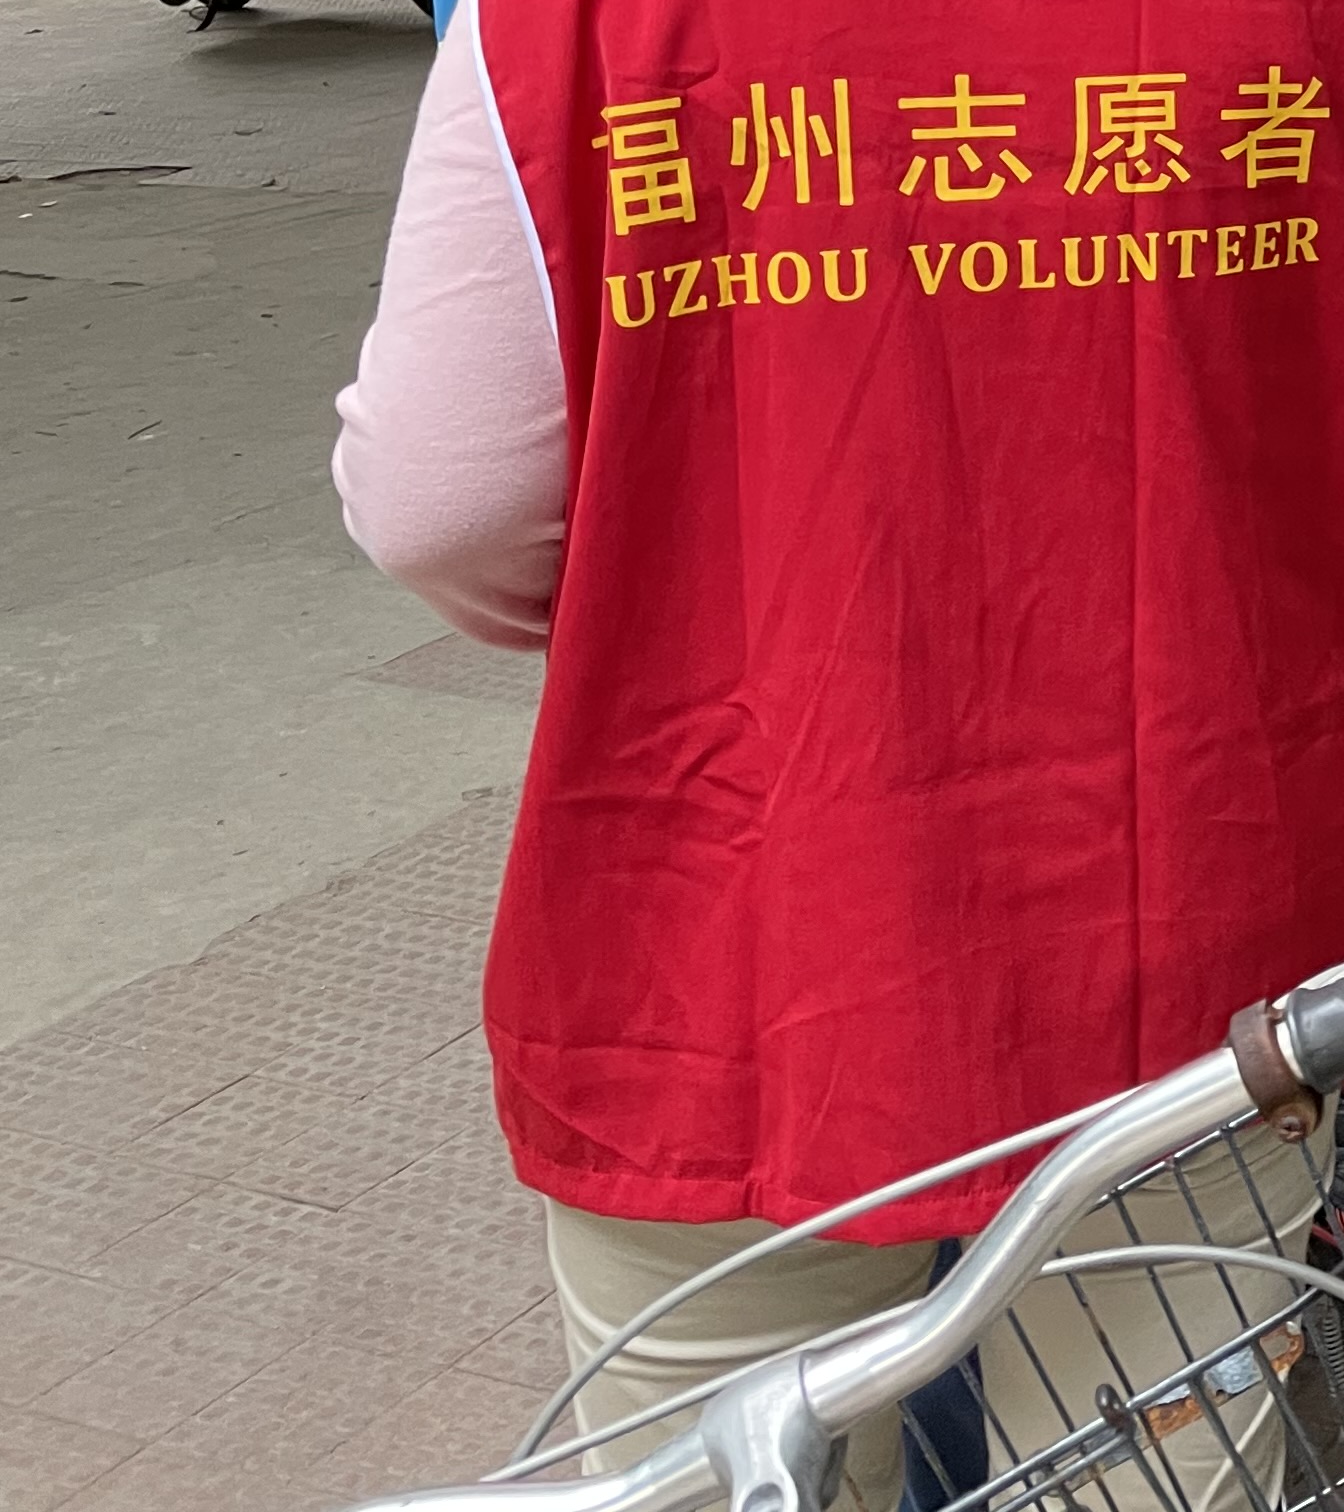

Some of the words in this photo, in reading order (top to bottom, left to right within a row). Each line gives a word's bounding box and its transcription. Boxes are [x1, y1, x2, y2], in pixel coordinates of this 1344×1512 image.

[591, 65, 1331, 237] 福州志愿者
[909, 216, 1321, 297] VOLUNTEER
